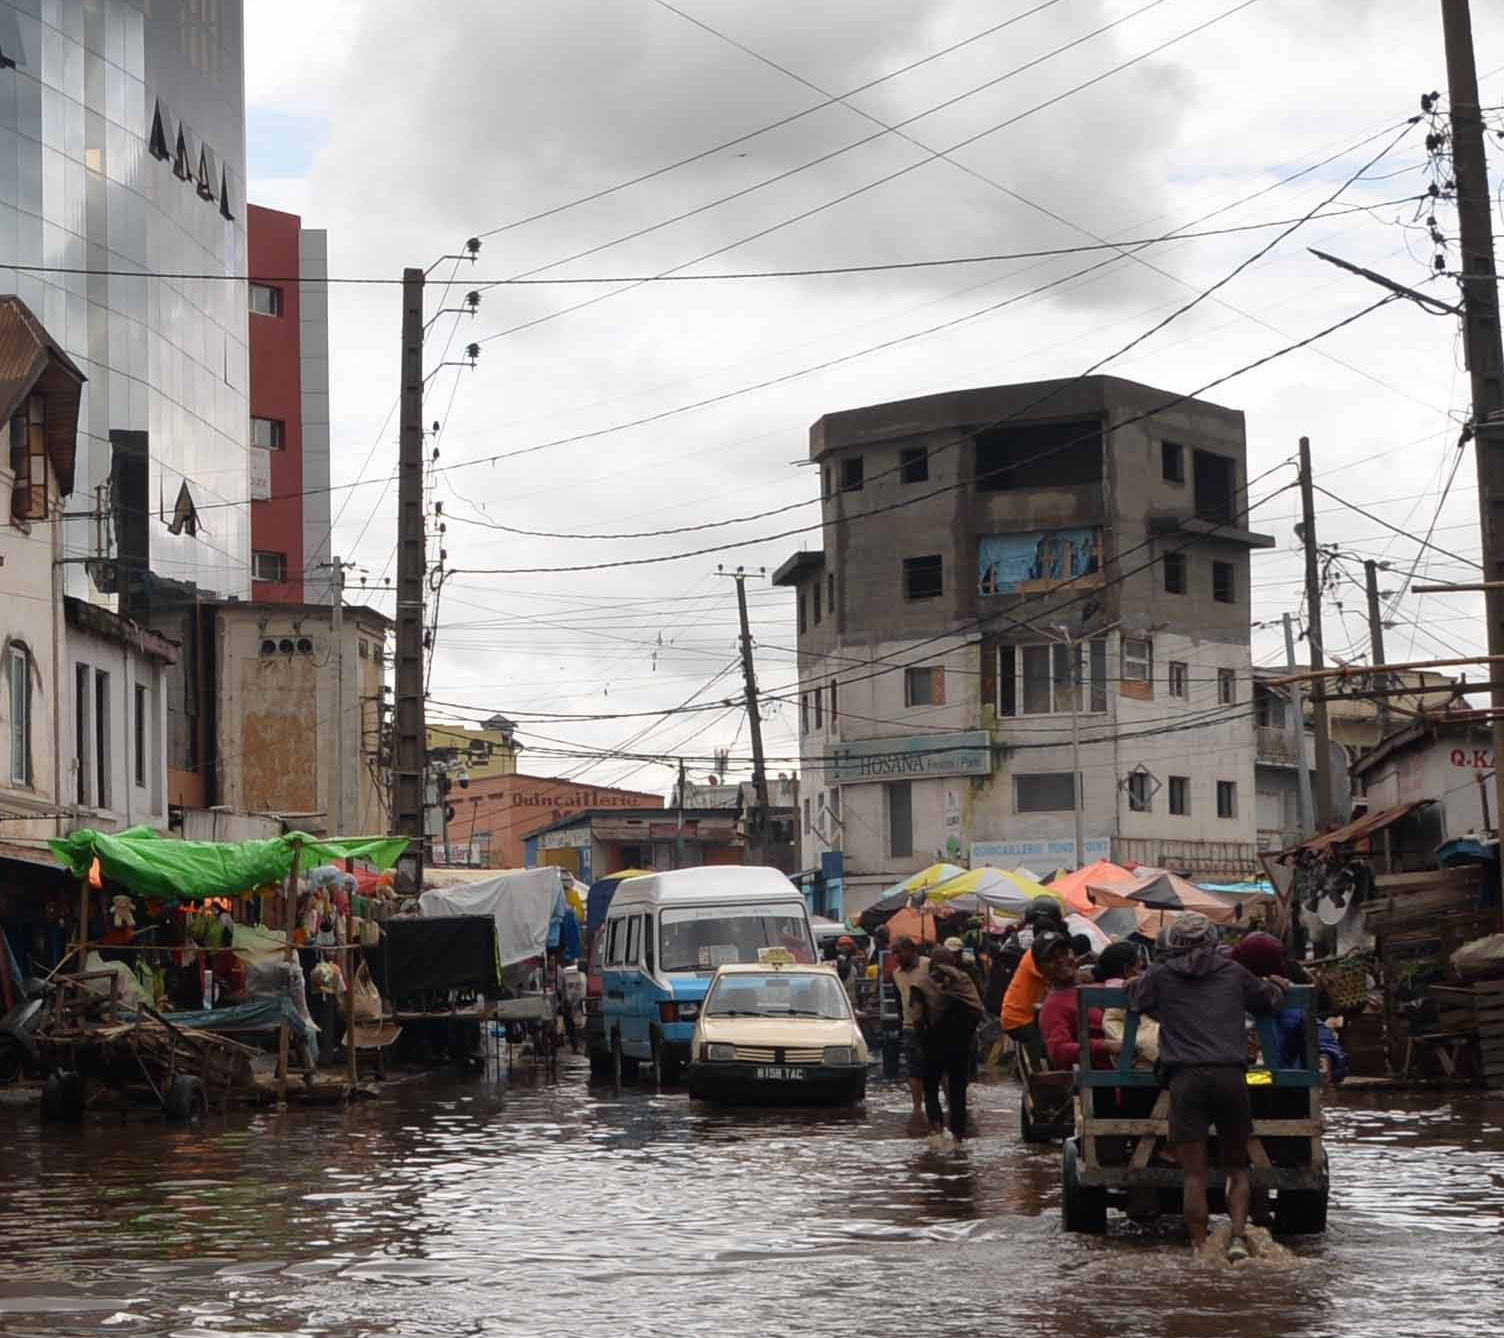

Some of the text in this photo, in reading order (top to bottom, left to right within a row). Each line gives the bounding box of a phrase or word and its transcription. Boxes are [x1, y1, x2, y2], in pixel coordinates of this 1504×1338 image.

[859, 754, 925, 775] HOSANA
[512, 789, 640, 807] Quincaillerie
[784, 1068, 803, 1079] TAC
